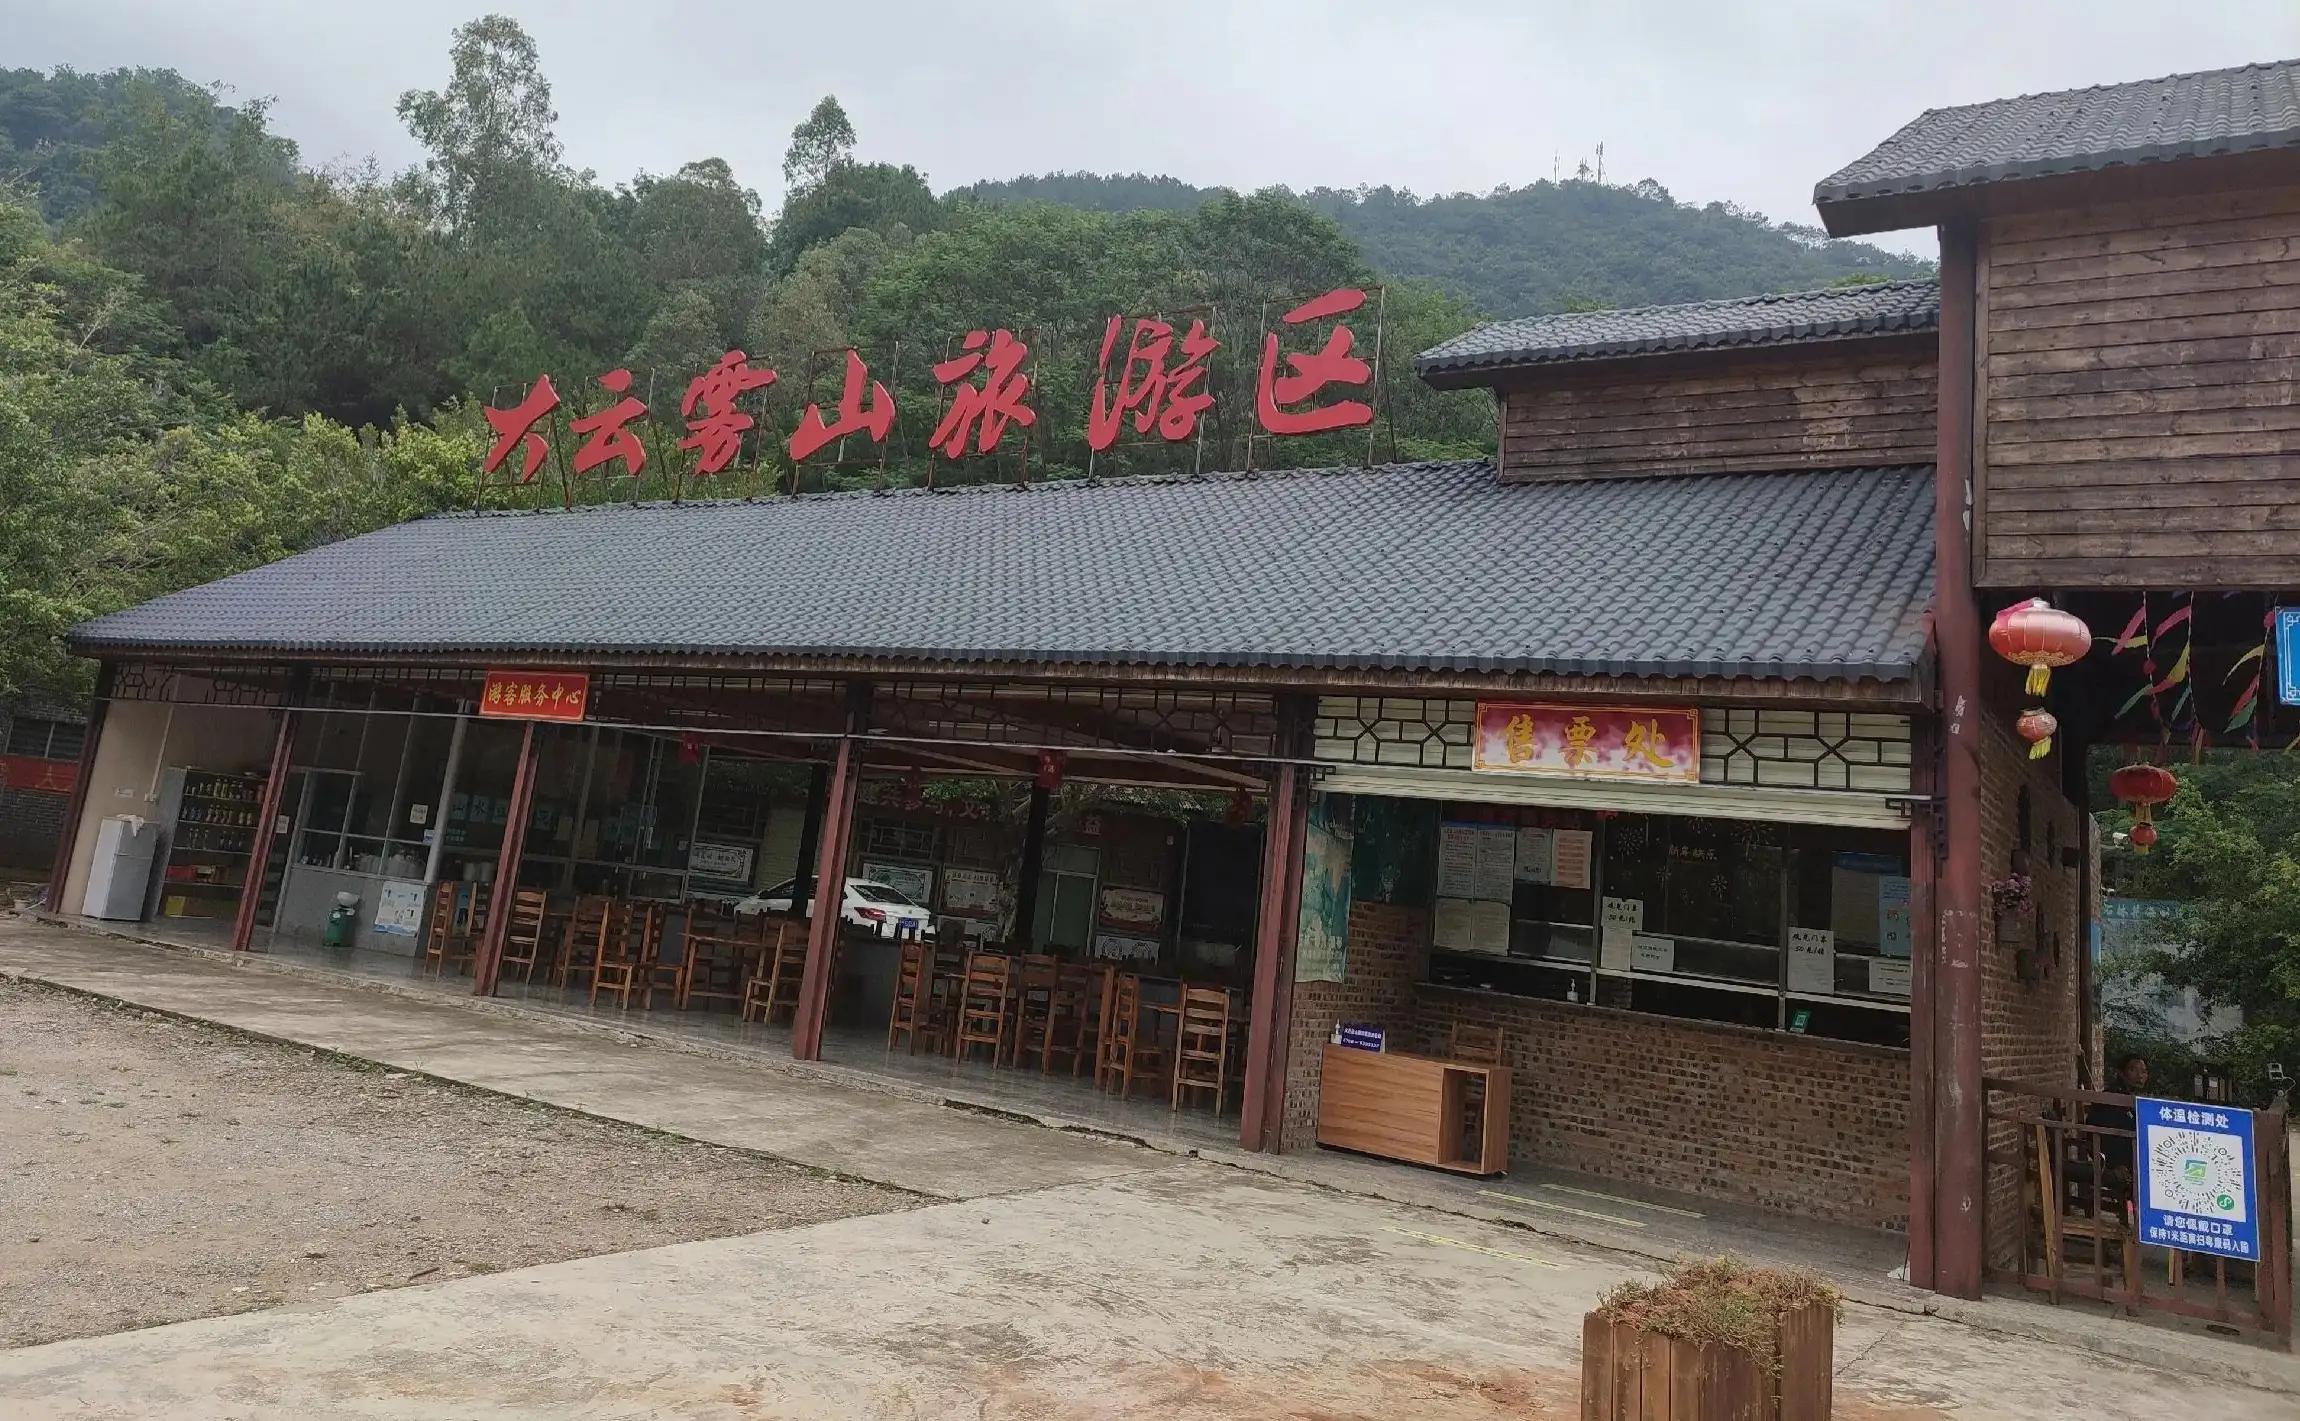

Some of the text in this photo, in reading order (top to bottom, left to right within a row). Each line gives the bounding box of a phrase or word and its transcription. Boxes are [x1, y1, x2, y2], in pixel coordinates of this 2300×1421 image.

[484, 288, 1374, 484] 大云雾山旅游区
[488, 681, 582, 711] 游客服务中心
[1506, 713, 1675, 769] 售票处
[2159, 1106, 2230, 1129] 体温检测处
[2149, 1226, 2250, 1254] 保持1米距离扫粤康码入园
[2163, 1214, 2234, 1237] 请您佩戴口罩
